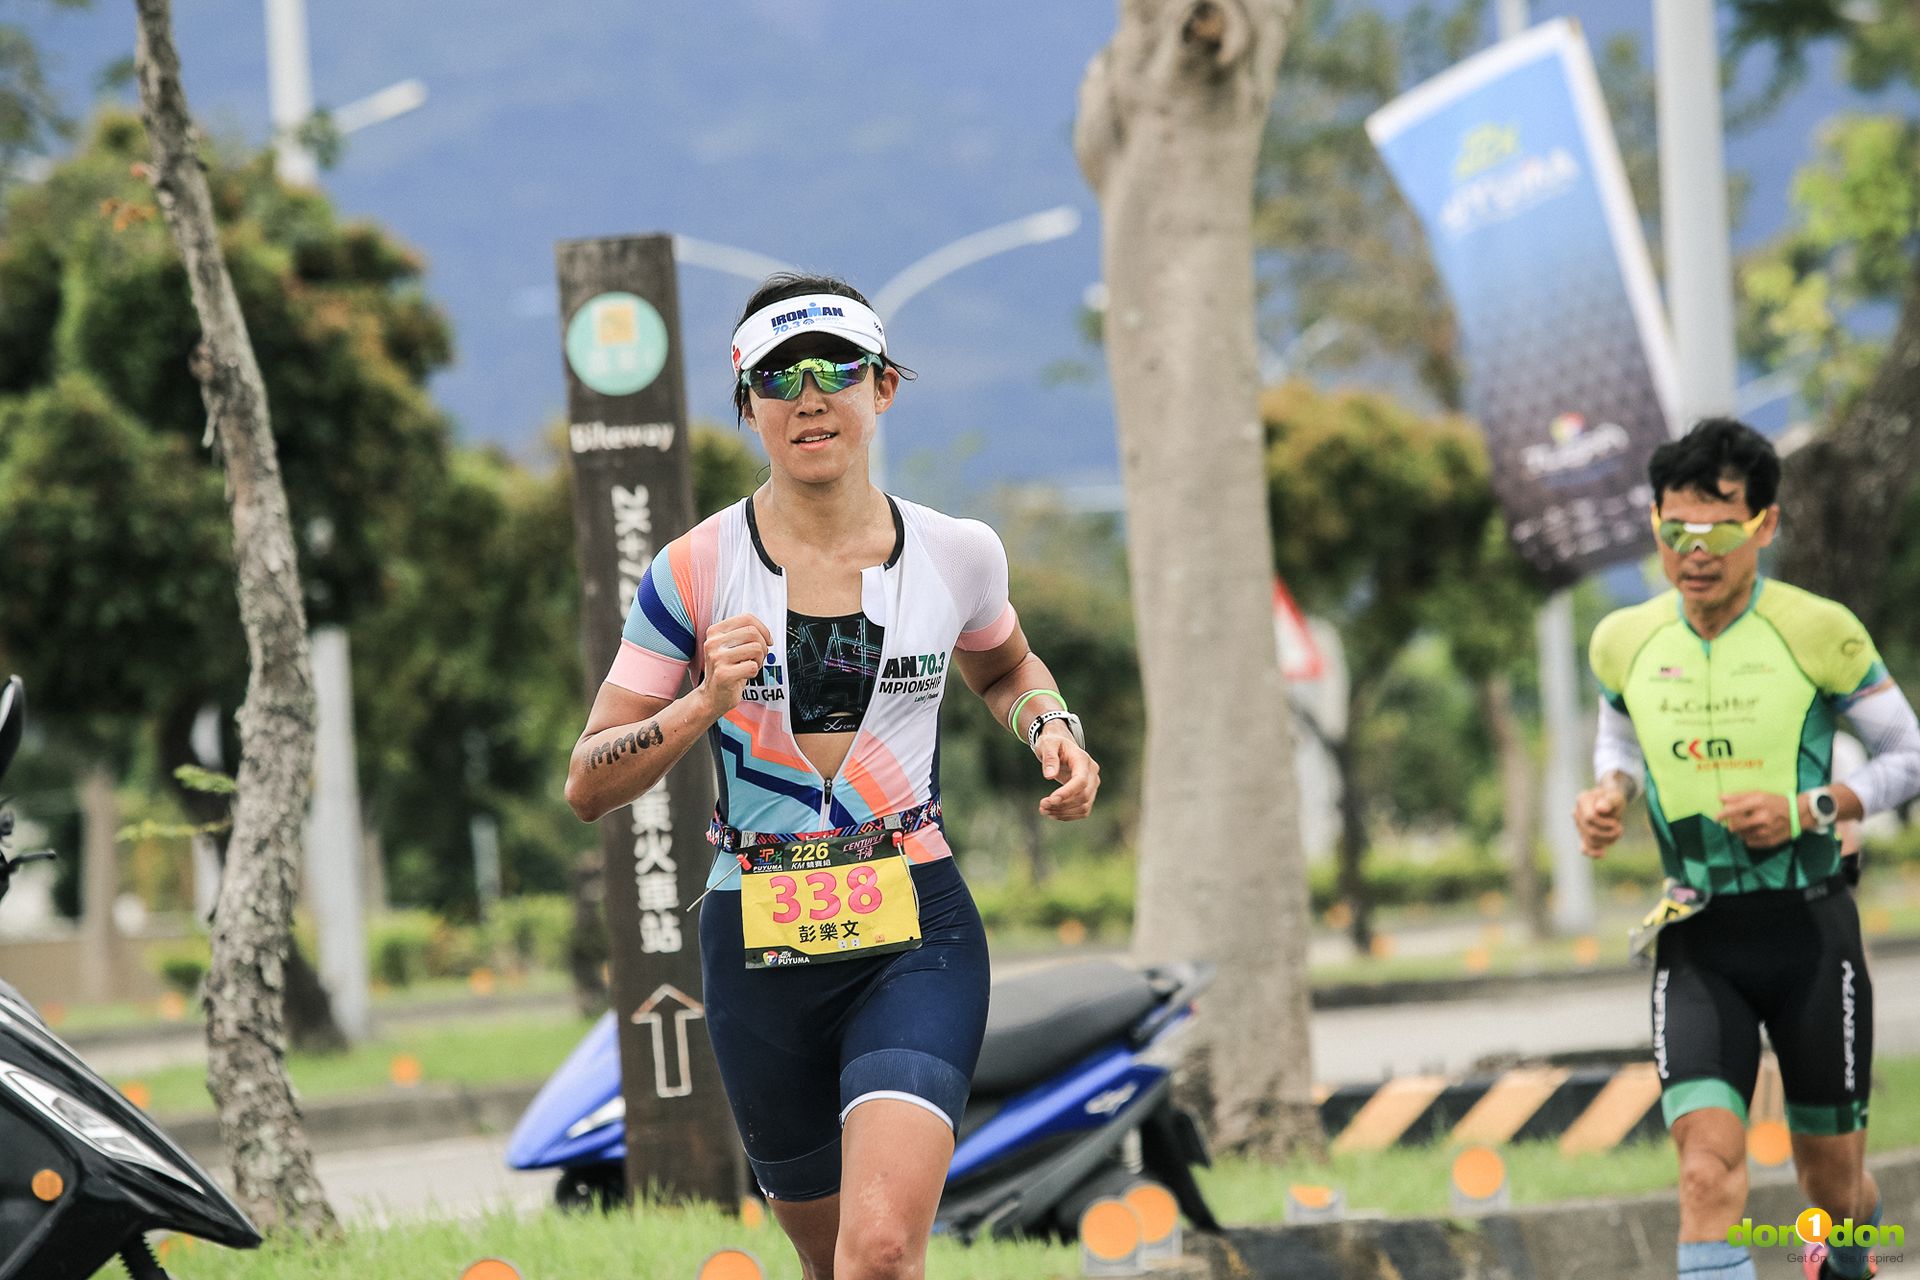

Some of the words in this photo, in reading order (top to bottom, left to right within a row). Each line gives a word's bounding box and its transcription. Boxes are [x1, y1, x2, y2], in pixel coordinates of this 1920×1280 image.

[771, 302, 844, 327] IRONMAN
[773, 321, 800, 335] 70.3
[879, 676, 942, 694] MPIONSHIP
[762, 688, 784, 701] CHA
[792, 842, 829, 862] 226
[632, 776, 683, 953] 東火車站
[753, 864, 783, 872] PUYUMA
[791, 862, 805, 870] KM
[769, 865, 883, 924] 338
[798, 920, 860, 944] 彭樂文
[778, 957, 810, 965] PUYUMA
